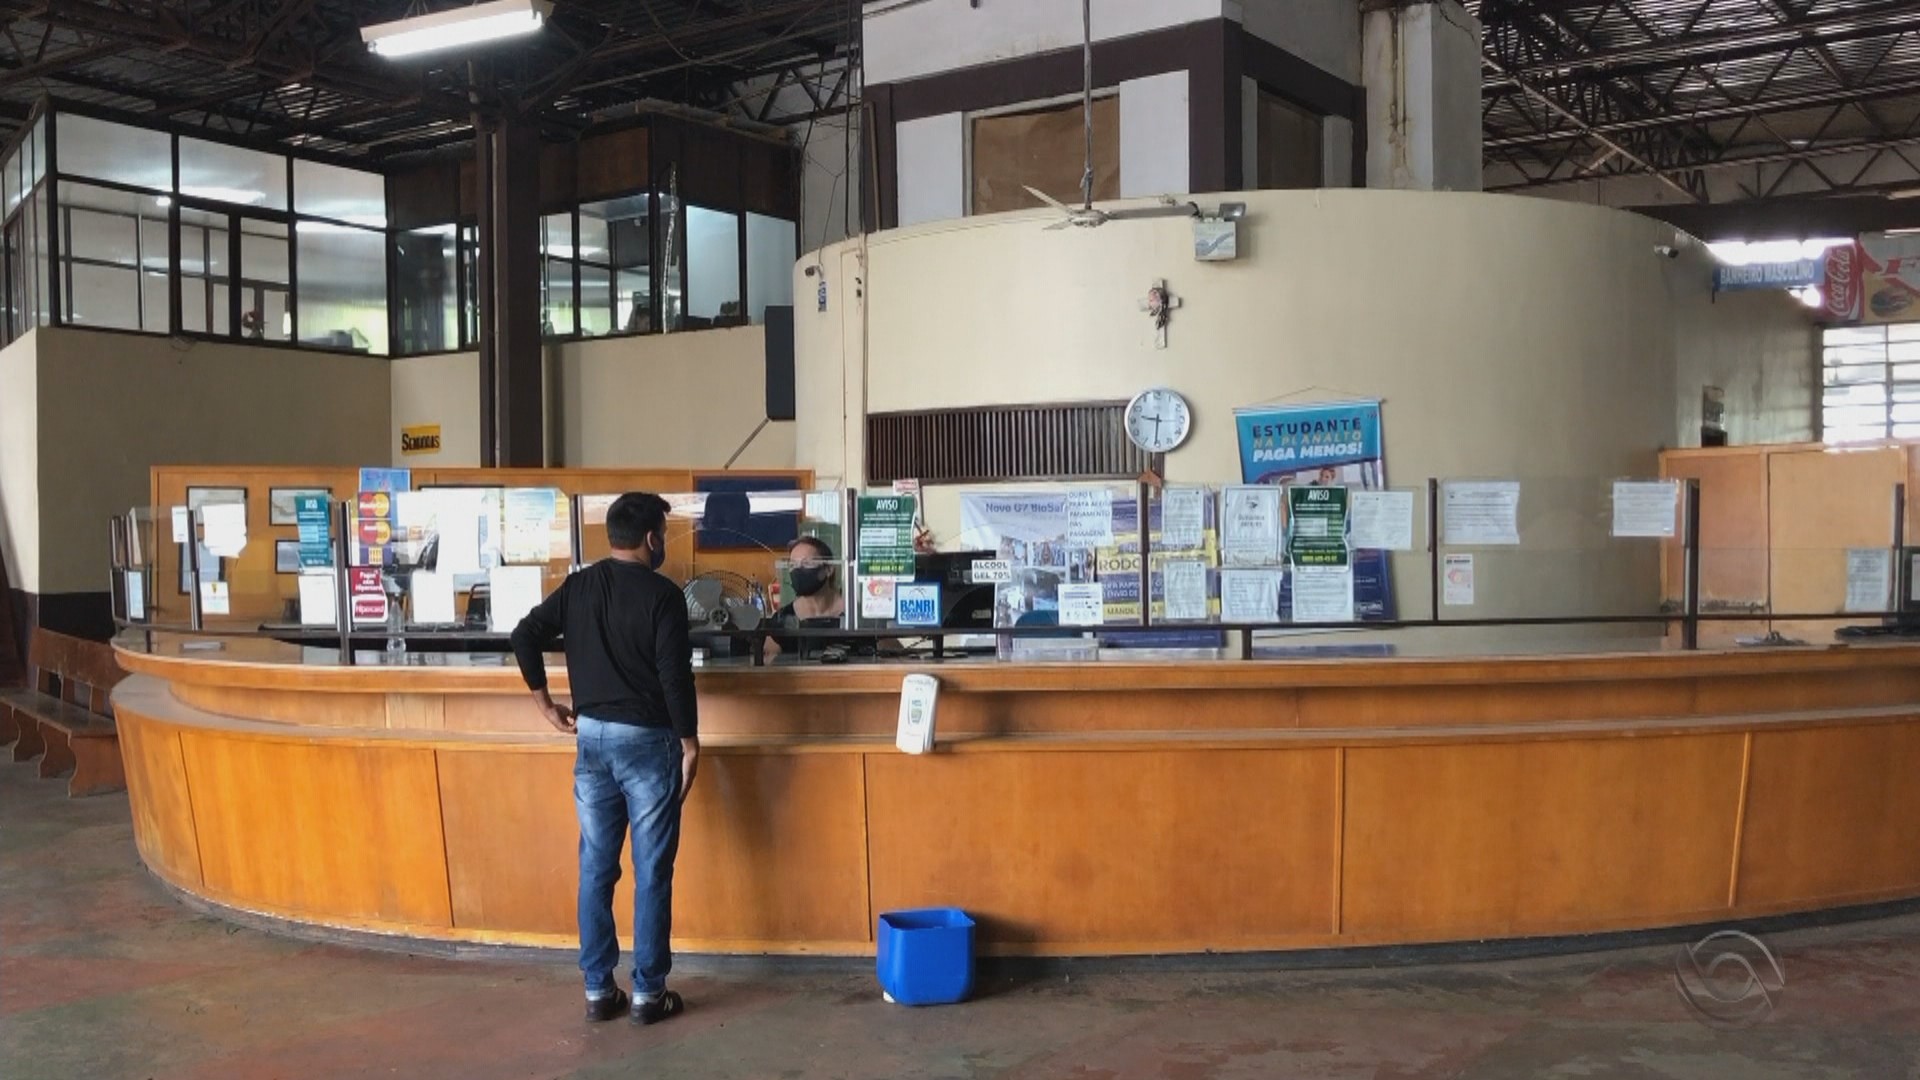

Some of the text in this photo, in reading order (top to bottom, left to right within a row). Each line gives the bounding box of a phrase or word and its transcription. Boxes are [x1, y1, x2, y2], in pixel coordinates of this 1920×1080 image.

[1720, 262, 1815, 285] BANHEIRO MASCULINO
[1252, 417, 1362, 438] ESTUDANTE
[1253, 431, 1362, 449] NA PLANALTO
[1253, 442, 1363, 463] PAGA MENOS!
[1307, 489, 1330, 501] AVISO
[876, 499, 898, 511] AVISO
[986, 503, 1011, 513] Novo
[1031, 502, 1066, 513] BioSaf
[974, 561, 1008, 569] ALCOOL
[974, 571, 1010, 579] GEL 70%
[900, 599, 935, 612] BANRI
